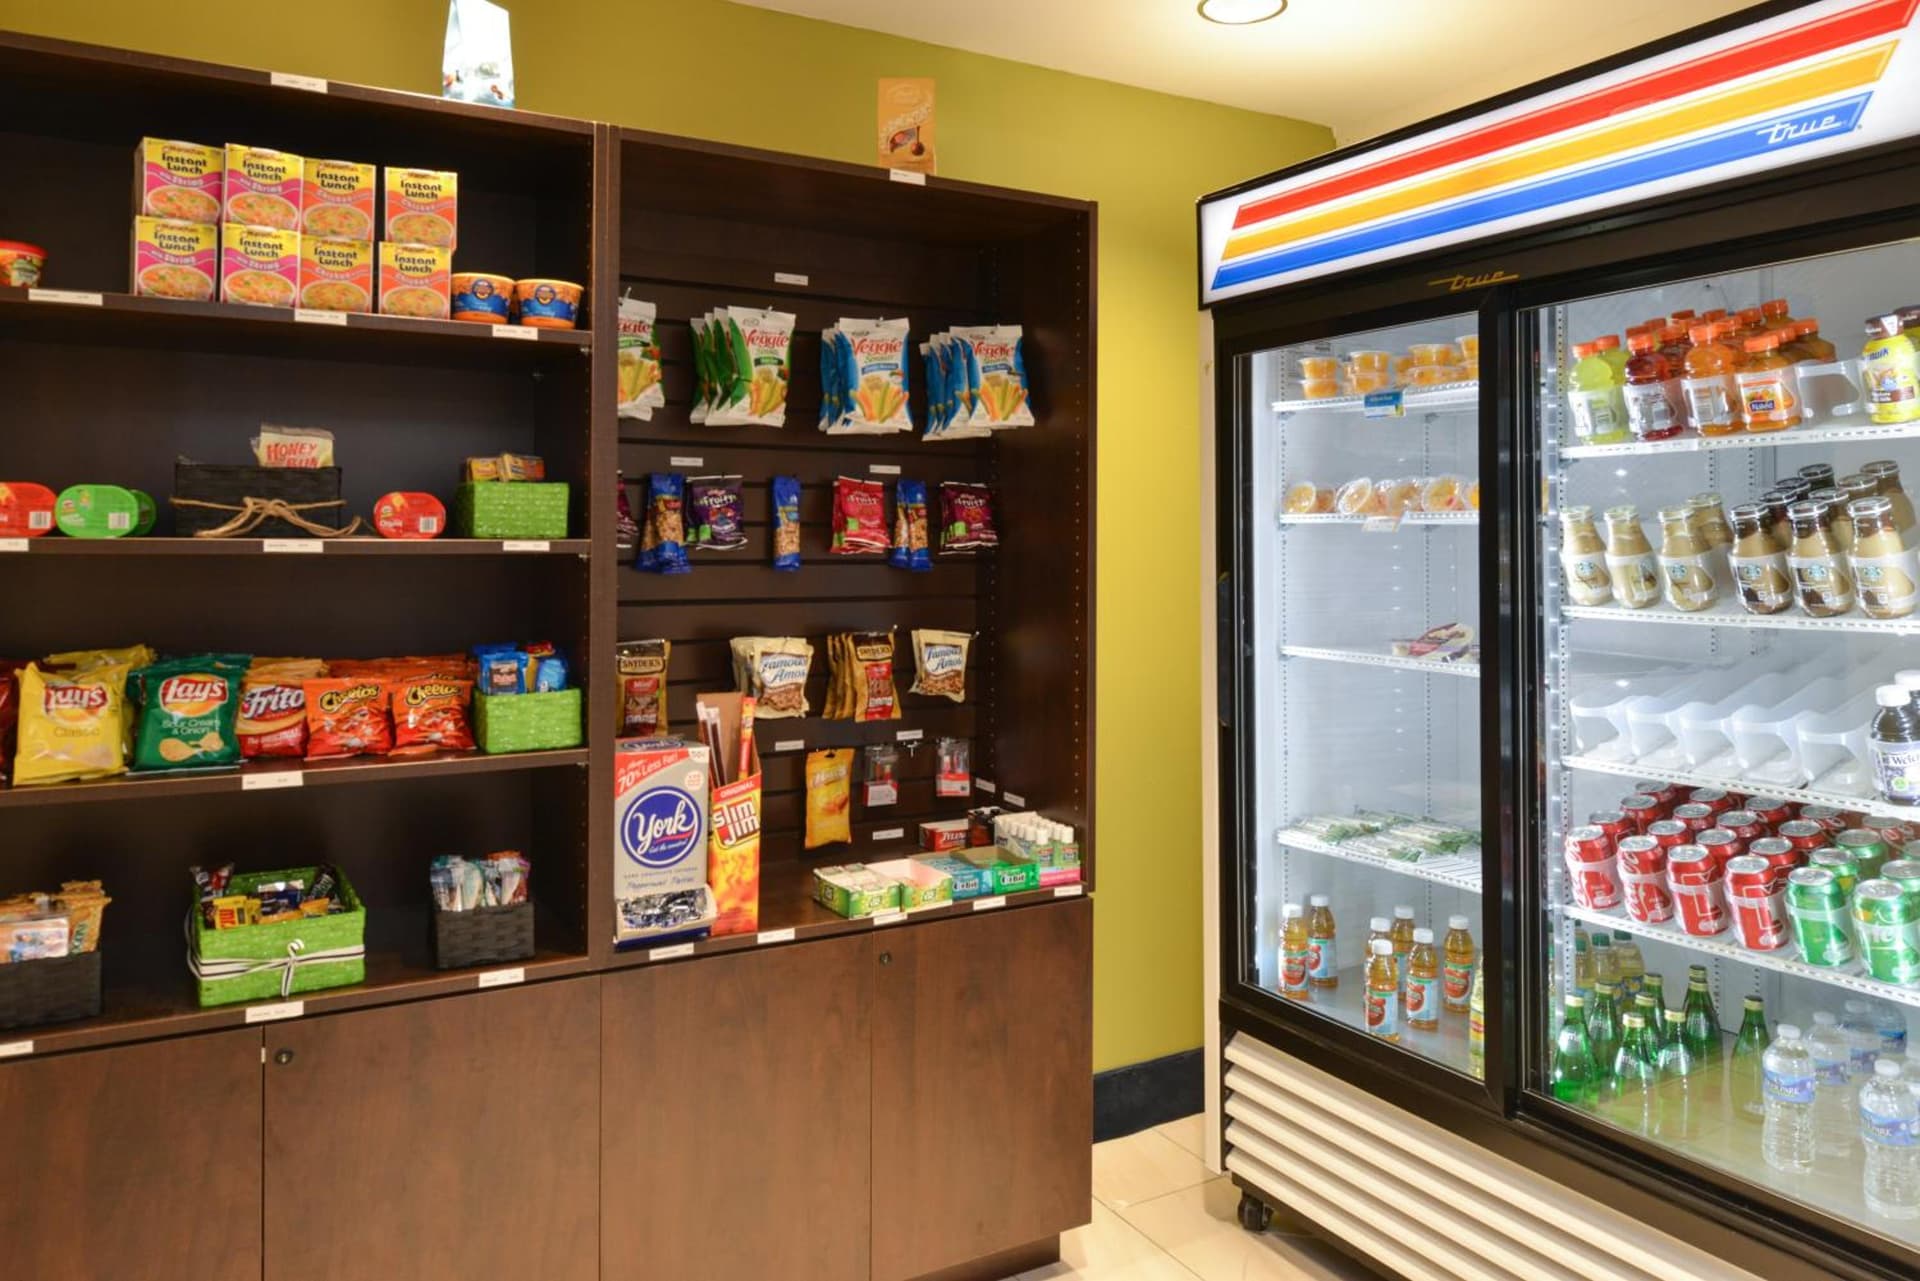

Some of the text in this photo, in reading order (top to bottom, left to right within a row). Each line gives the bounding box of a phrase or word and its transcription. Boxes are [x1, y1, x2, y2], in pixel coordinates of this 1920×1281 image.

[1756, 115, 1842, 144] true
[162, 153, 207, 167] Instant
[243, 160, 286, 173] Instant
[167, 162, 203, 174] Lunch
[248, 169, 282, 181] Lunch
[316, 170, 359, 183] Instant
[320, 179, 355, 191] Lunch
[400, 180, 443, 191] Instant
[405, 188, 438, 199] Lunch
[153, 231, 200, 245] Instant
[239, 237, 283, 251] Instant
[158, 240, 196, 253] Lunch
[244, 246, 279, 259] Lunch
[314, 247, 358, 261] Instant
[394, 253, 437, 266] Instant
[318, 256, 354, 268] Lunch
[398, 262, 434, 274] Lunch
[1427, 271, 1519, 291] true
[744, 329, 789, 348] Veggie
[850, 337, 903, 355] Veggie
[972, 340, 1014, 357] Veggie
[266, 442, 318, 463] HONEY
[762, 657, 806, 671] Famous
[933, 657, 963, 672] Amos
[770, 667, 806, 684] Amos
[166, 678, 227, 702] Lay's
[242, 686, 305, 719] Frito
[321, 686, 380, 712] Cheetos
[162, 719, 221, 729] Sour Cream
[182, 726, 210, 736] Onion
[642, 759, 662, 777] Less
[720, 781, 755, 798] ORIGINAL
[632, 799, 696, 856] York
[942, 831, 967, 841] TYLEN
